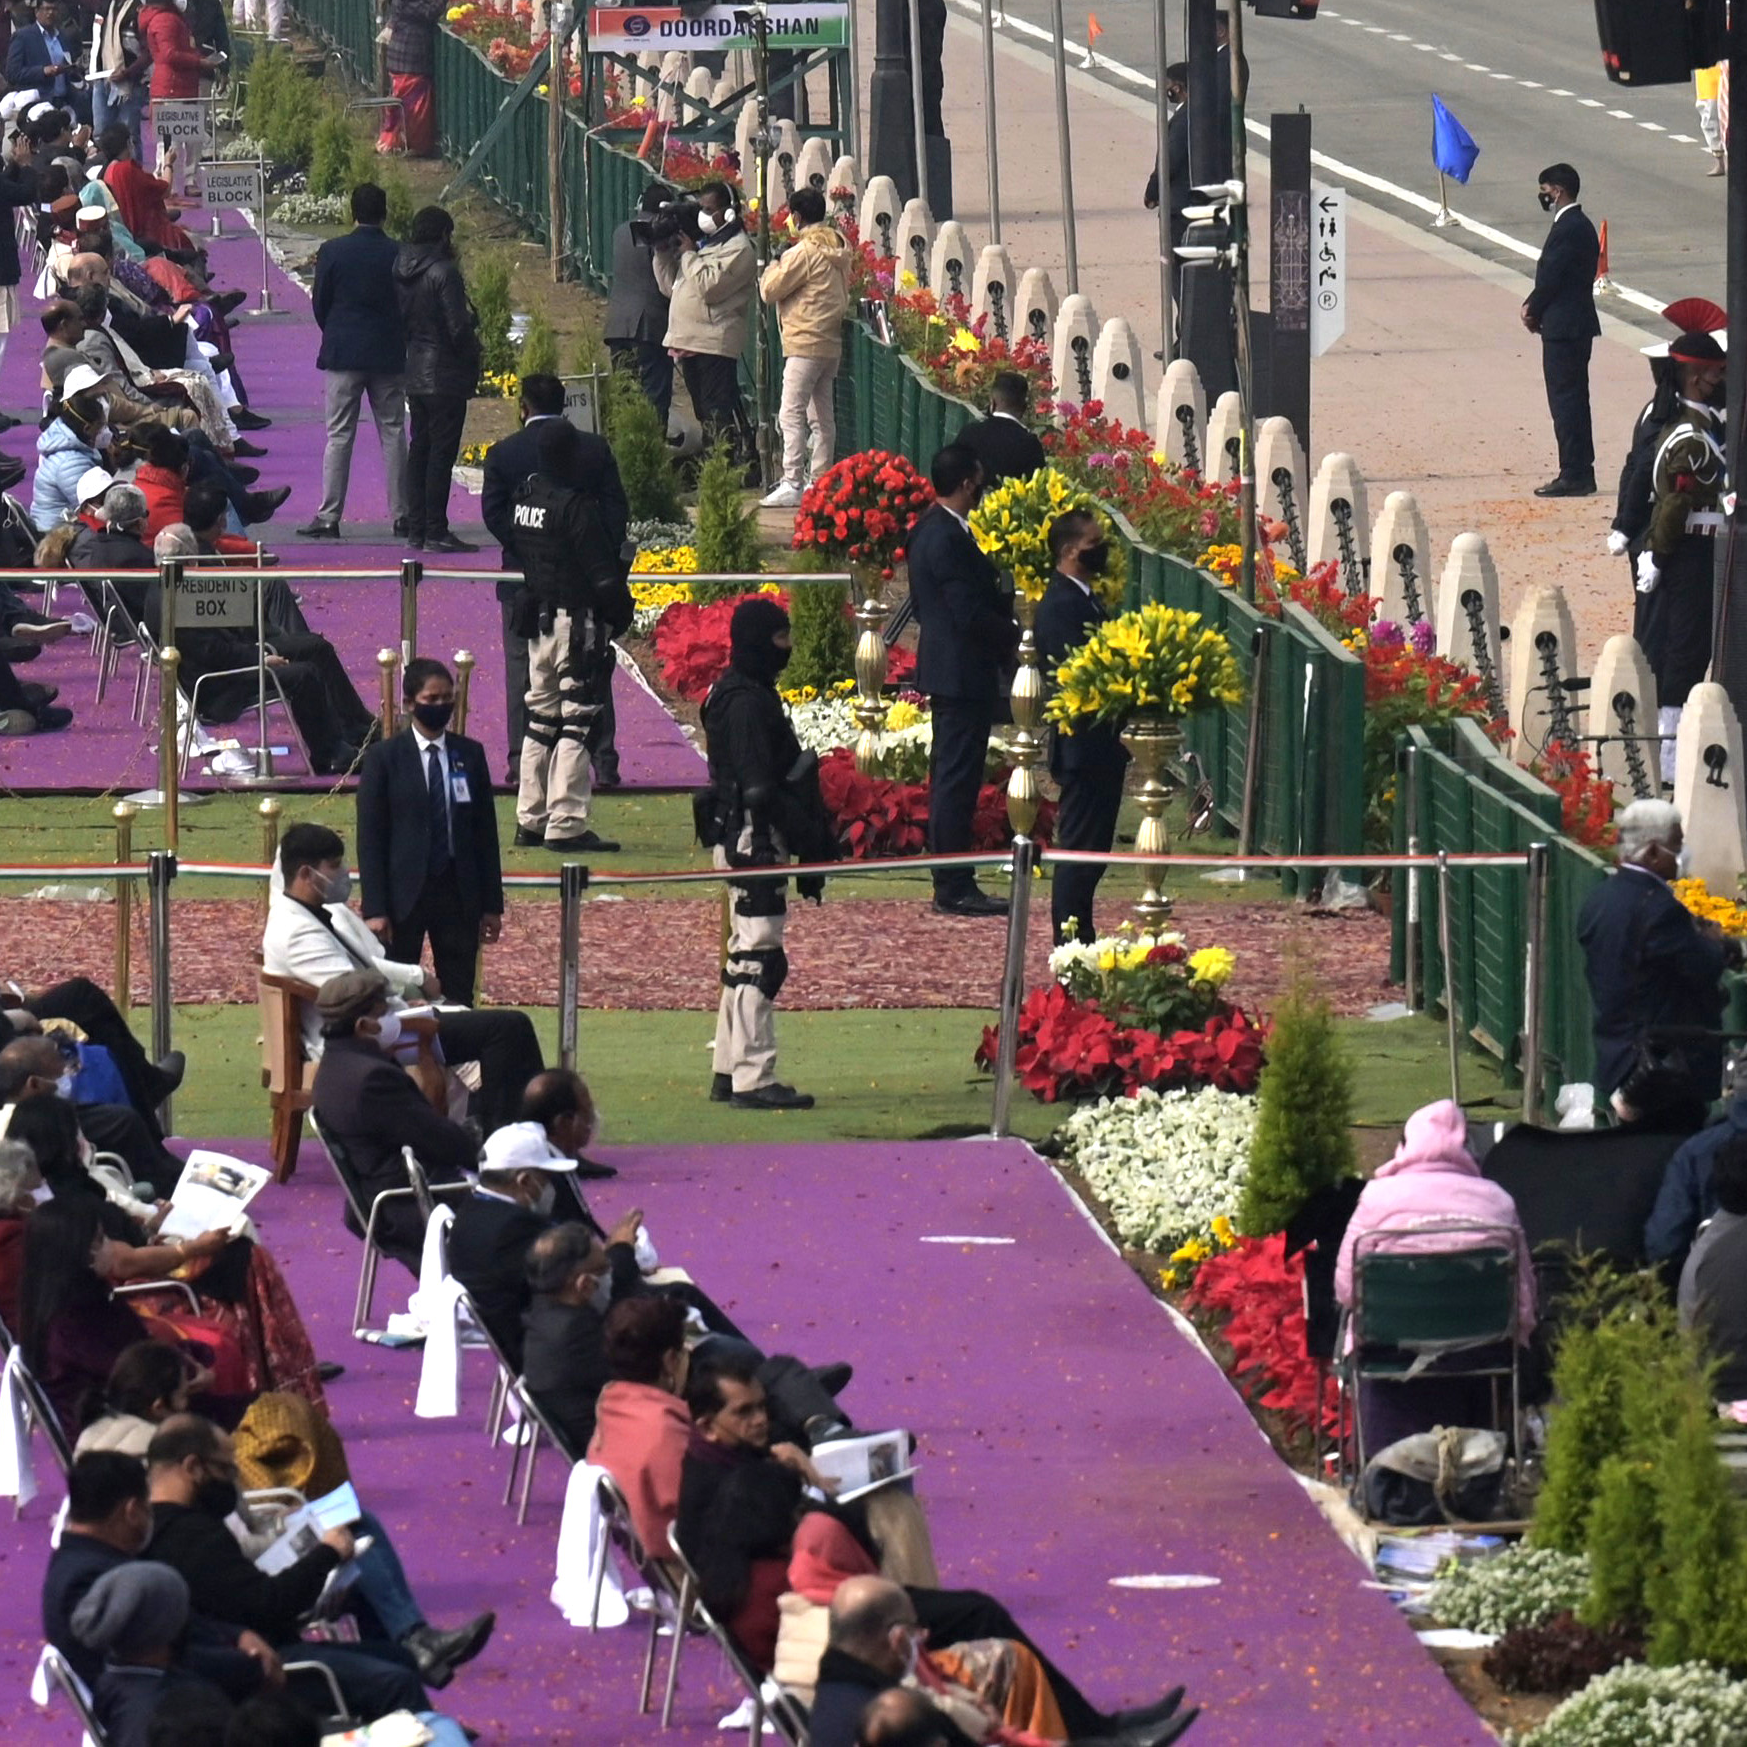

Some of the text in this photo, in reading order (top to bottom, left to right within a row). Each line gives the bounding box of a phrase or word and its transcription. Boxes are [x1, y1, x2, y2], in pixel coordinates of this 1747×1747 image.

[660, 17, 819, 38] DOORDASHAN
[157, 111, 200, 122] LEGISLATIVE
[157, 124, 200, 135] BLOCK
[207, 175, 253, 188] LEGISLATIVE
[208, 190, 253, 203] BLOCK
[514, 504, 546, 528] POLICE
[175, 579, 248, 594] PRESIDENTS
[196, 599, 226, 616] BOX
